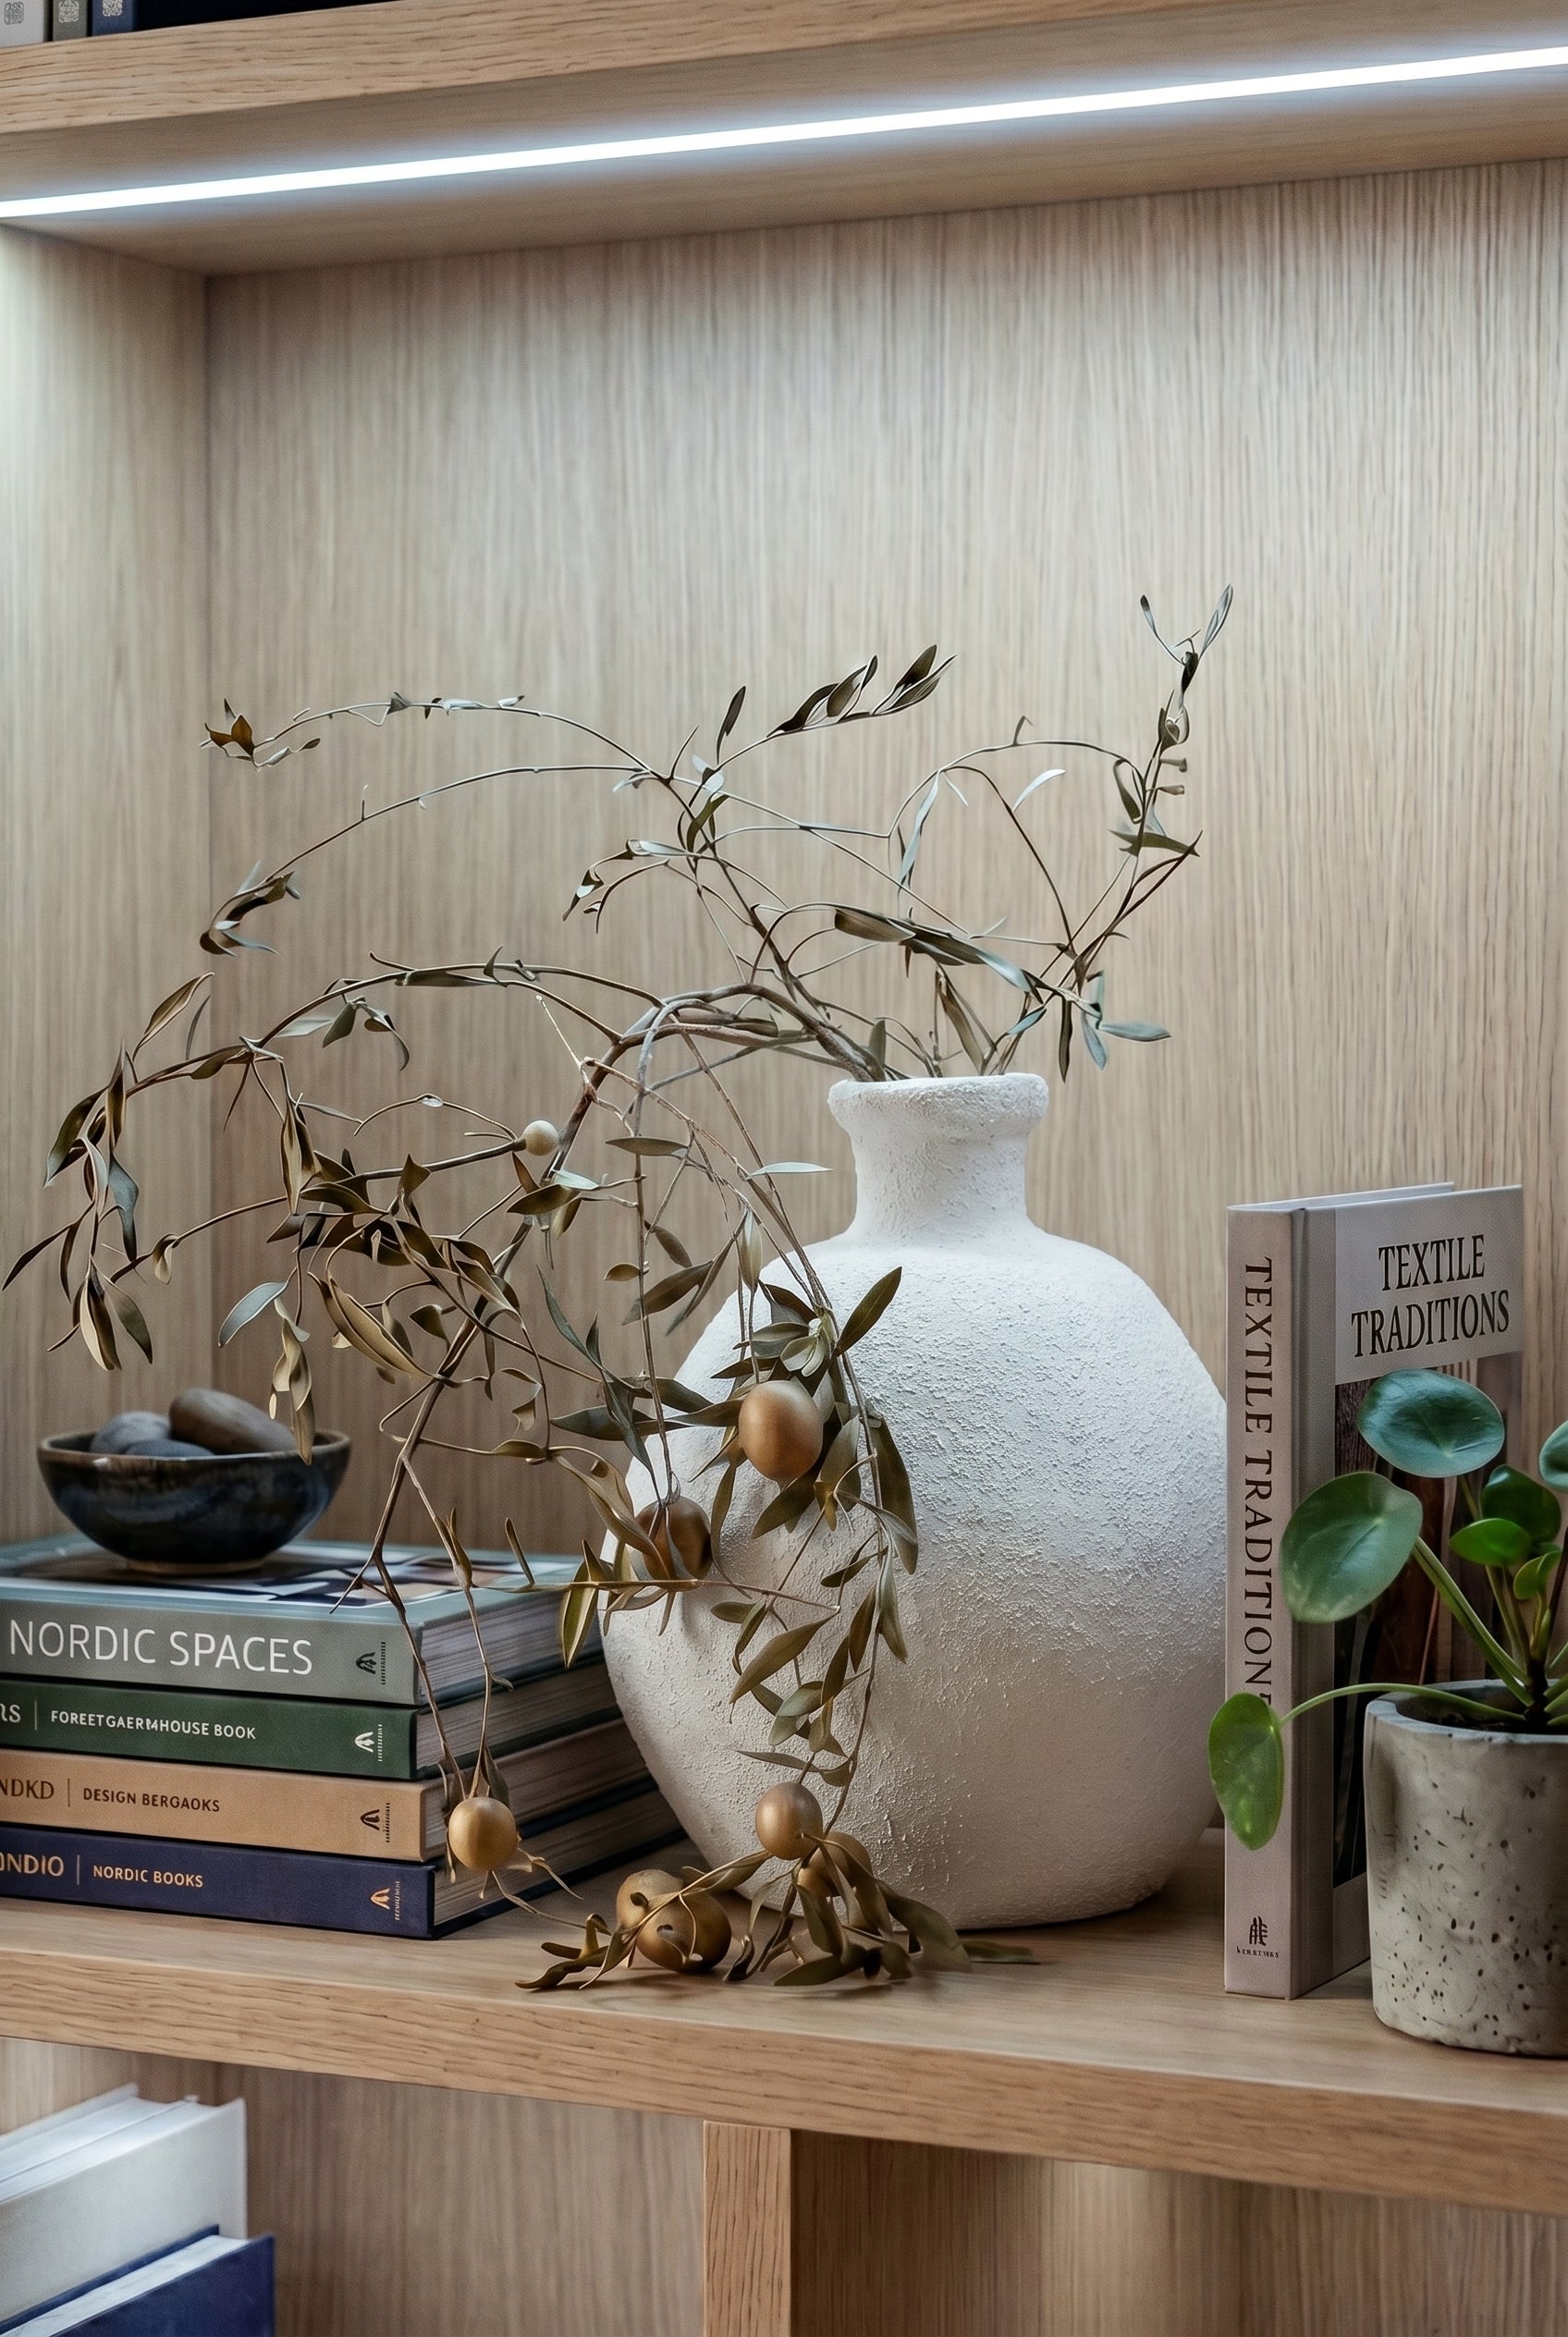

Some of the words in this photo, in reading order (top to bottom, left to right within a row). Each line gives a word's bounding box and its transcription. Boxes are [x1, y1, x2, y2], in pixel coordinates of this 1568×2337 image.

[1378, 1234, 1485, 1291] TEXTILE
[1245, 1256, 1272, 1433] TEXTILE
[1351, 1290, 1510, 1357] TRADITIONS
[1244, 1450, 1272, 1706] TRADITION
[10, 1620, 156, 1664] NORDIC
[169, 1631, 312, 1675] SPACES
[214, 1724, 256, 1740] BOOK
[83, 1787, 137, 1805] DESIGN
[141, 1793, 220, 1813] BERGAOKS
[93, 1865, 149, 1883] NORDIC
[153, 1871, 203, 1888] BOOKS
